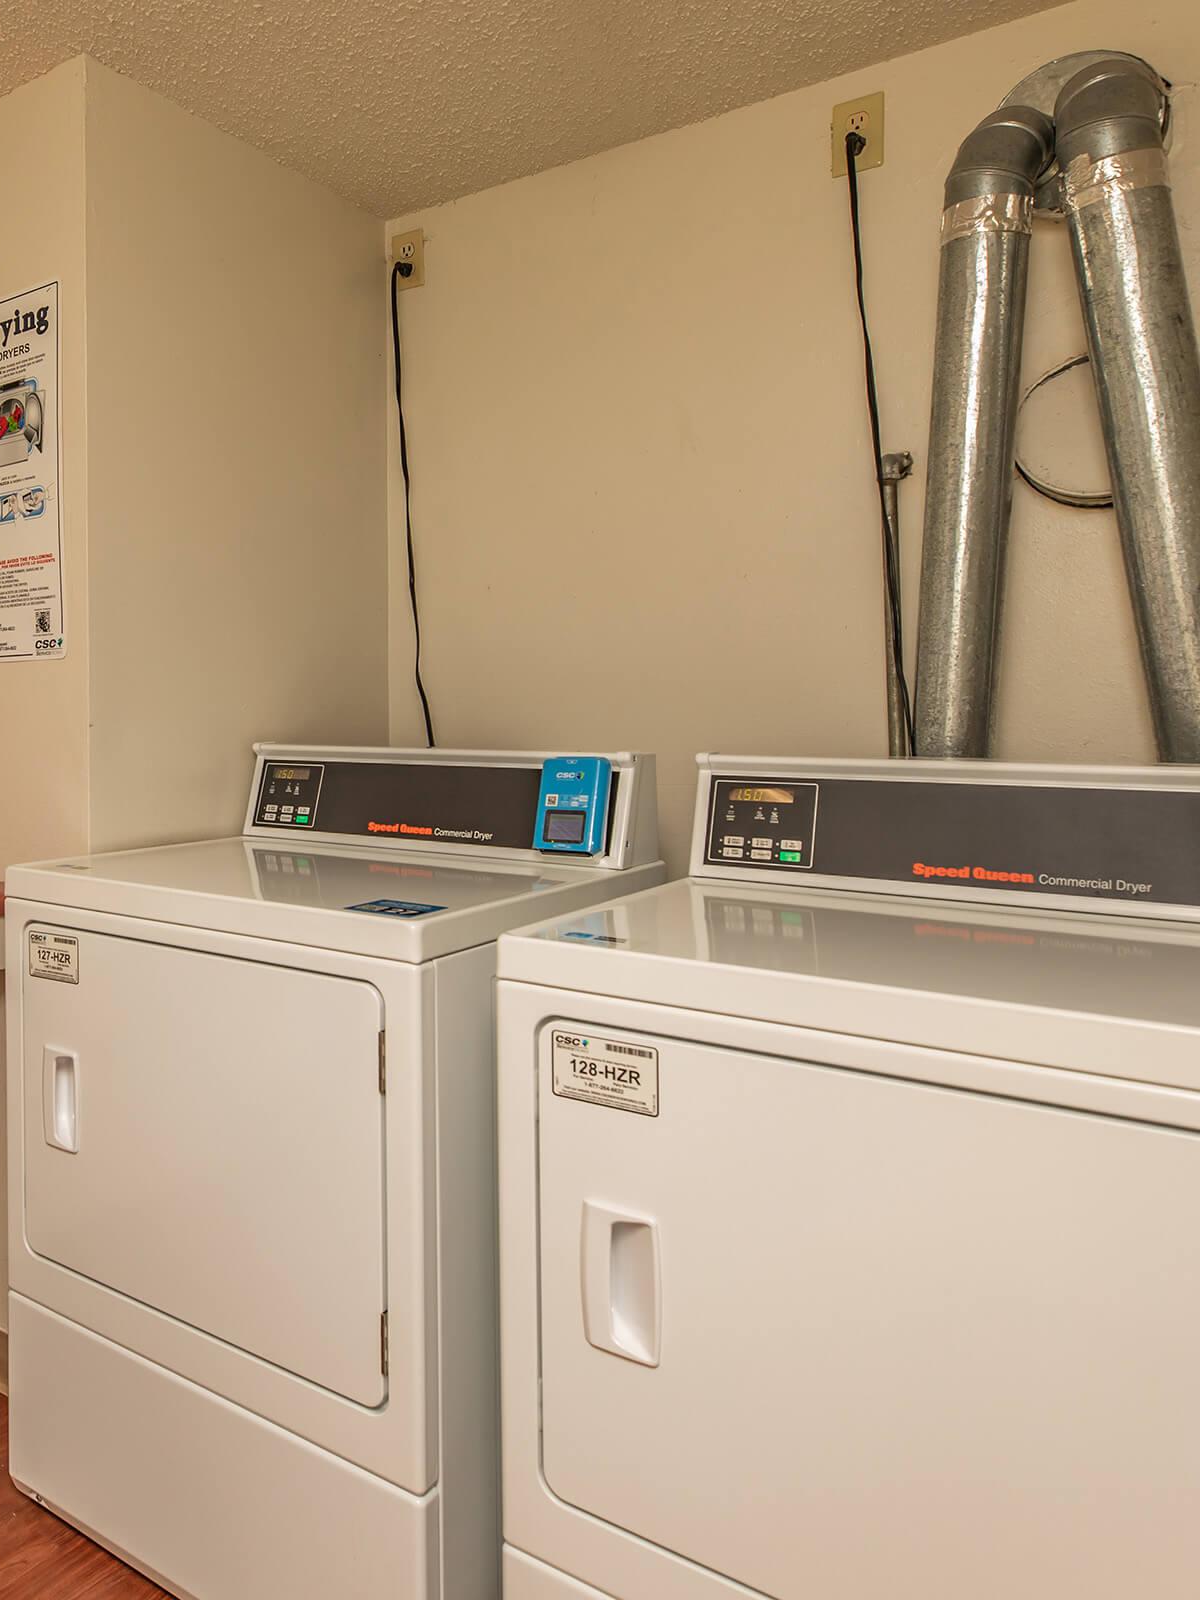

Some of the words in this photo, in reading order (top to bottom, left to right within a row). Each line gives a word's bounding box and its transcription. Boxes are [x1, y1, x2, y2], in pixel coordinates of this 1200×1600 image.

[35, 639, 56, 649] CSC
[368, 821, 399, 832] Speed
[400, 824, 432, 836] Queen
[434, 827, 473, 838] Commercial
[473, 831, 493, 840] Dryer
[912, 863, 970, 879] Speed
[972, 867, 1035, 884] Queen
[1038, 873, 1112, 890] Commercial
[1116, 880, 1152, 894] Dryer
[38, 949, 71, 964] 127-HZR
[556, 1035, 581, 1046] CSC
[570, 1059, 641, 1086] 128-HZR
